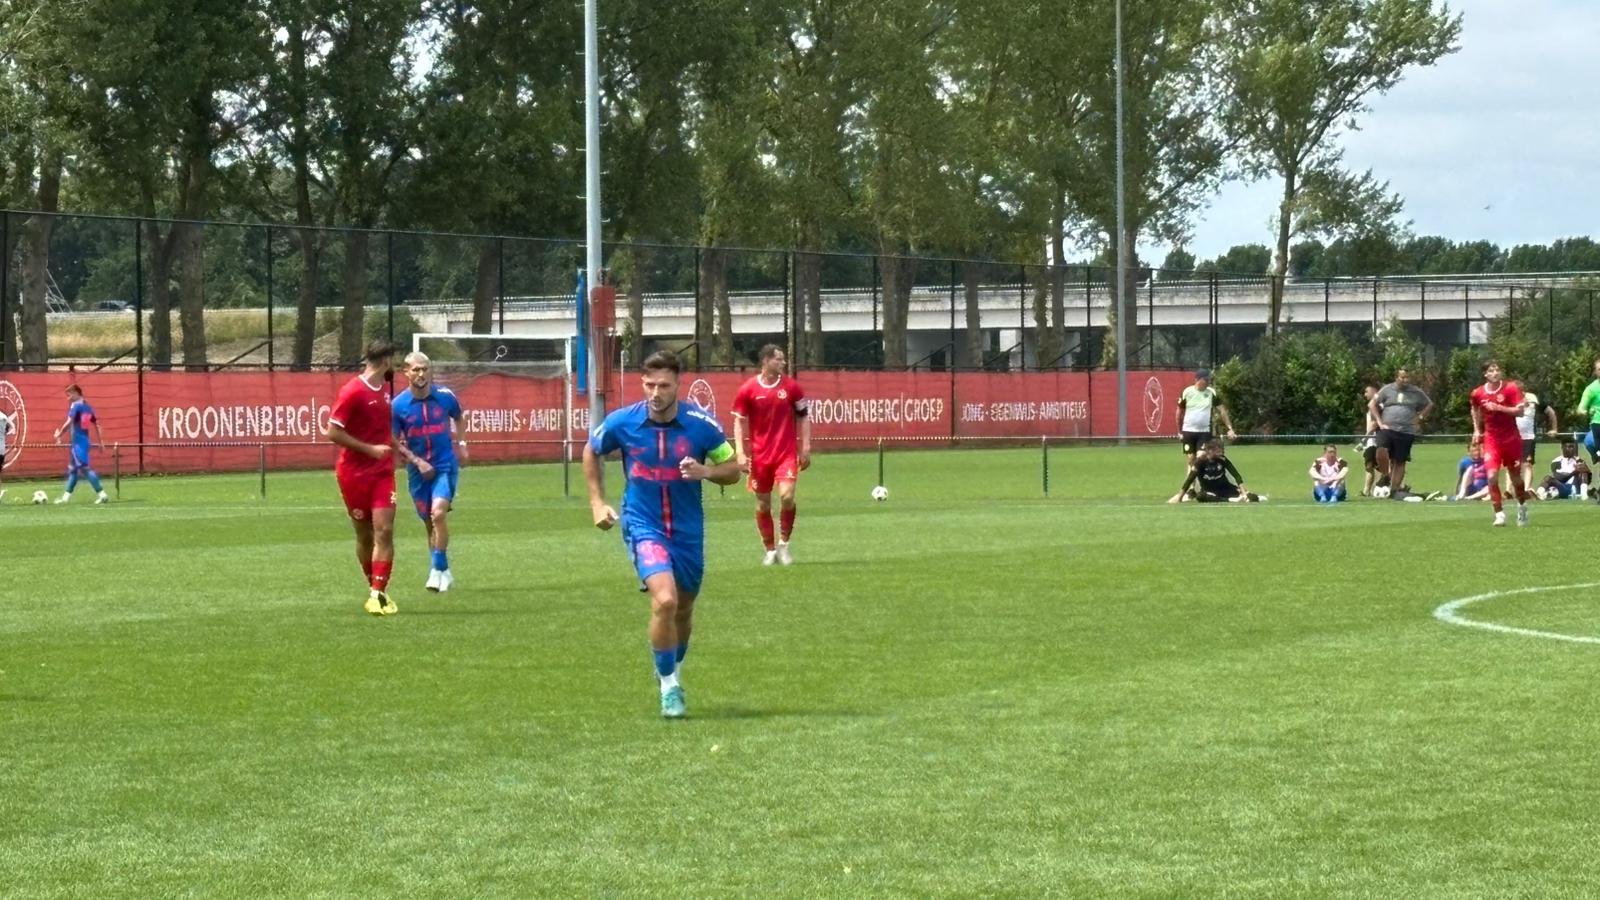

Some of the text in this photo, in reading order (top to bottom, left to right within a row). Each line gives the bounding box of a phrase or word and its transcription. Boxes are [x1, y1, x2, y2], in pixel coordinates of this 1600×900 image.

[158, 405, 310, 439] KROONENBERG
[807, 397, 944, 424] KROONENBERG GROEP
